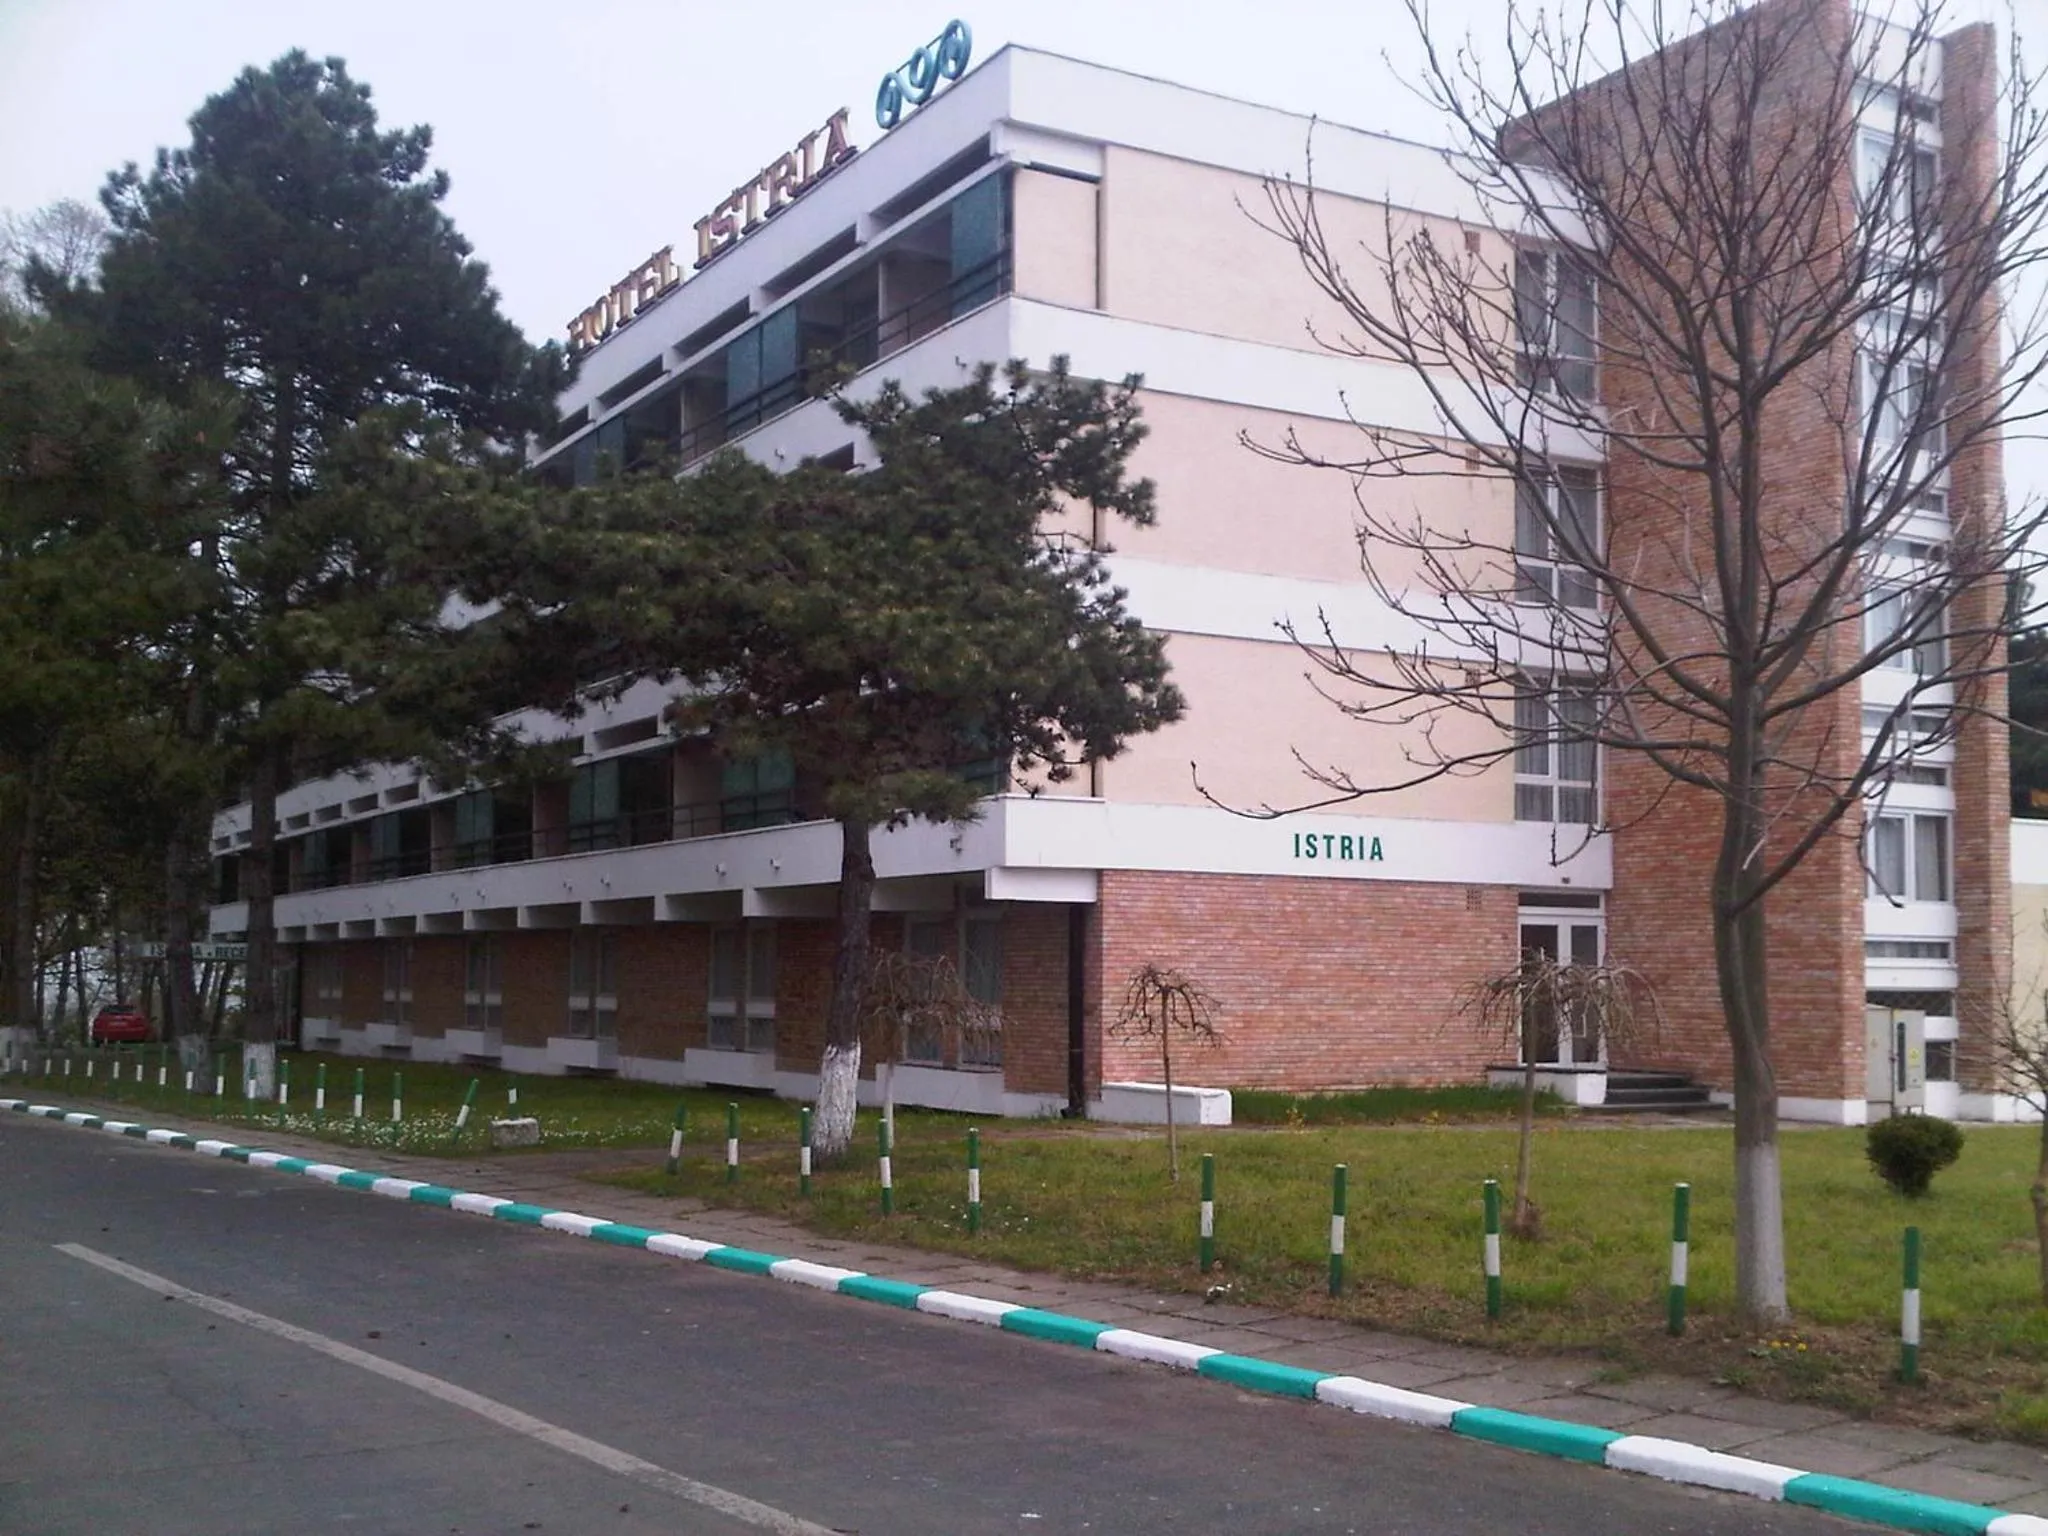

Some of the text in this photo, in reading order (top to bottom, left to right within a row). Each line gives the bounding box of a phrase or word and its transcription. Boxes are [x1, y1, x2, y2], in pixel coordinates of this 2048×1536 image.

[567, 106, 858, 355] HOTEL ISTRIA
[1294, 833, 1384, 861] ISTRIA
